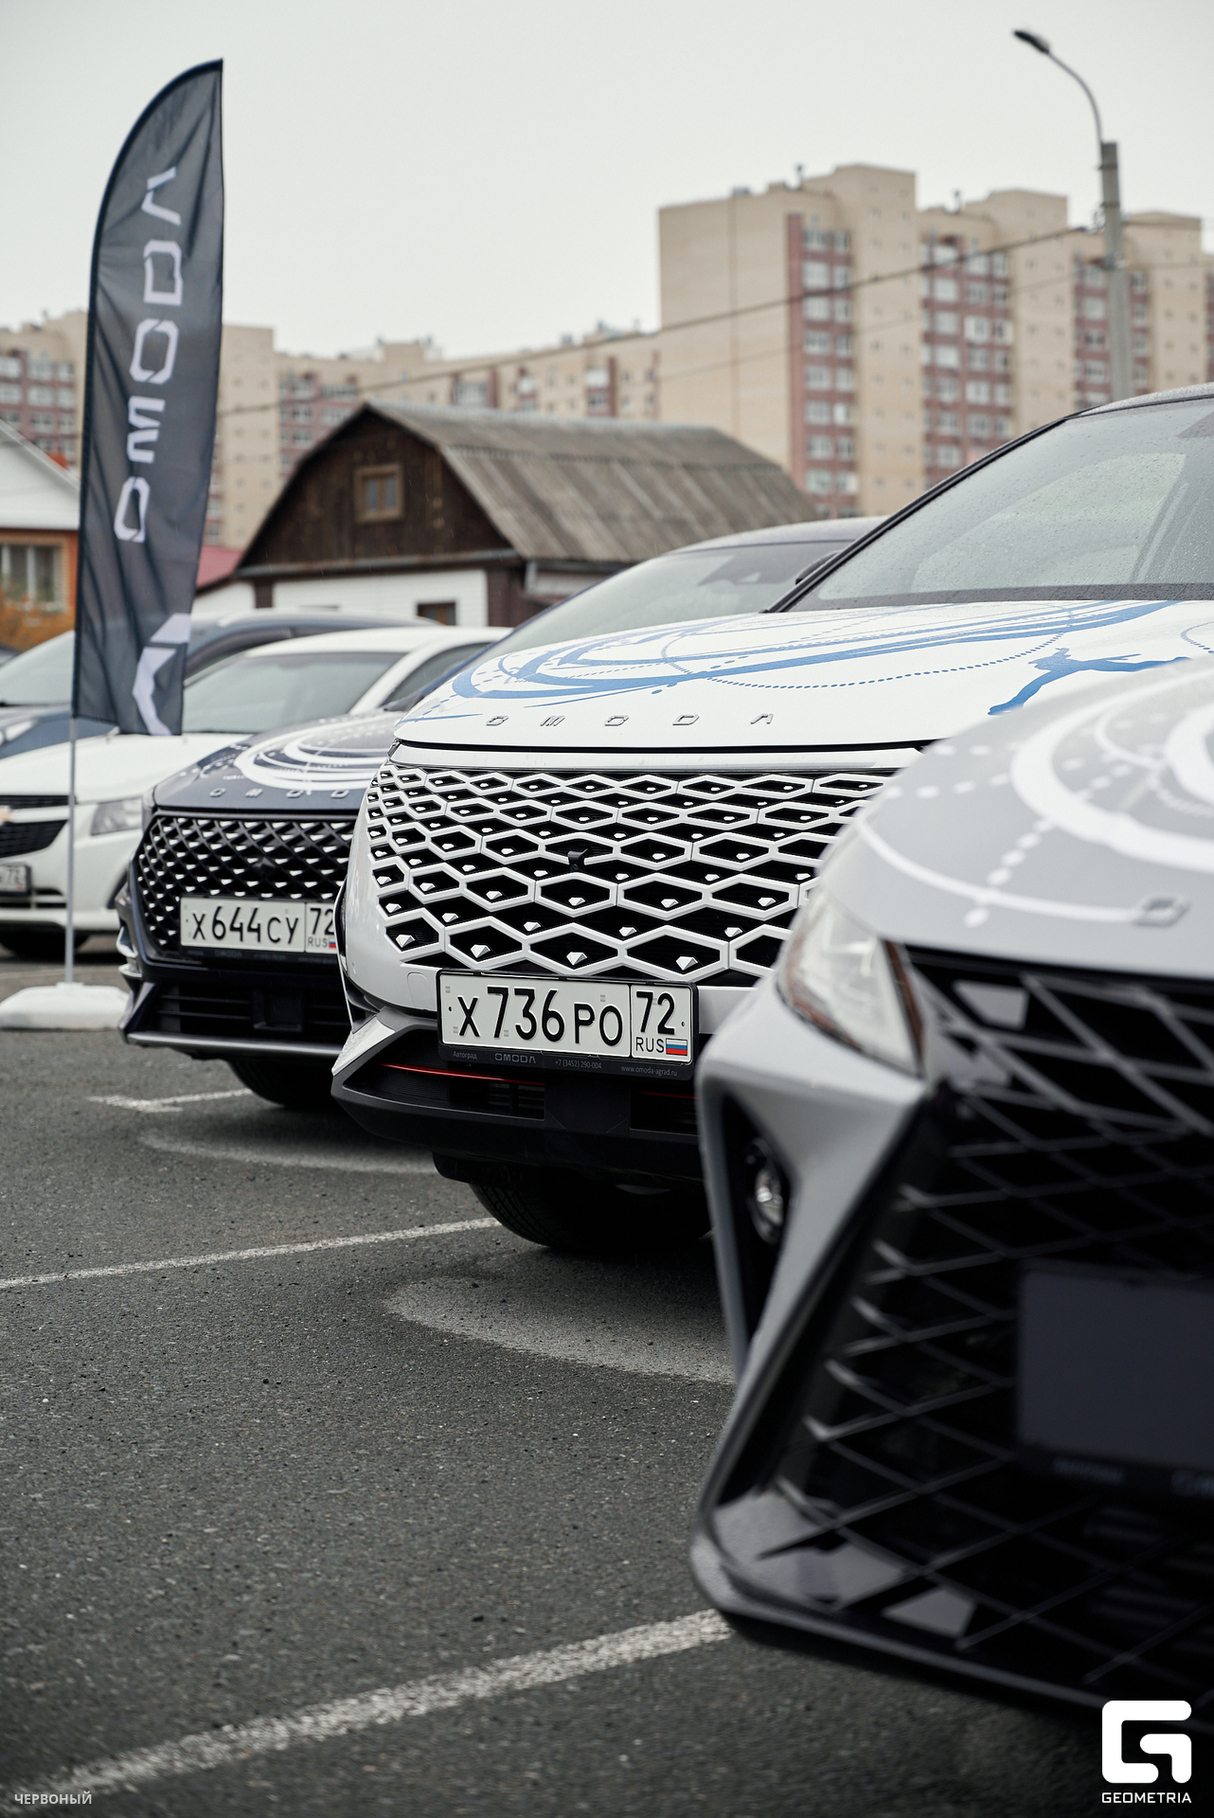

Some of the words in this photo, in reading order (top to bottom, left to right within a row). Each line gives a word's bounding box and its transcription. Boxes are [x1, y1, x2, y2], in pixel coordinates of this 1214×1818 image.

[485, 713, 774, 727] OMODA
[209, 787, 350, 798] OMOD
[307, 937, 328, 948] RUS
[636, 991, 675, 1036] 72
[635, 1036, 665, 1053] RUS
[452, 1050, 478, 1061] Автоград
[494, 1052, 536, 1064] OMODA
[563, 1060, 580, 1068] (3452)
[580, 1061, 602, 1069] 290-004
[620, 1065, 678, 1077] www.omoda-agrad.ru
